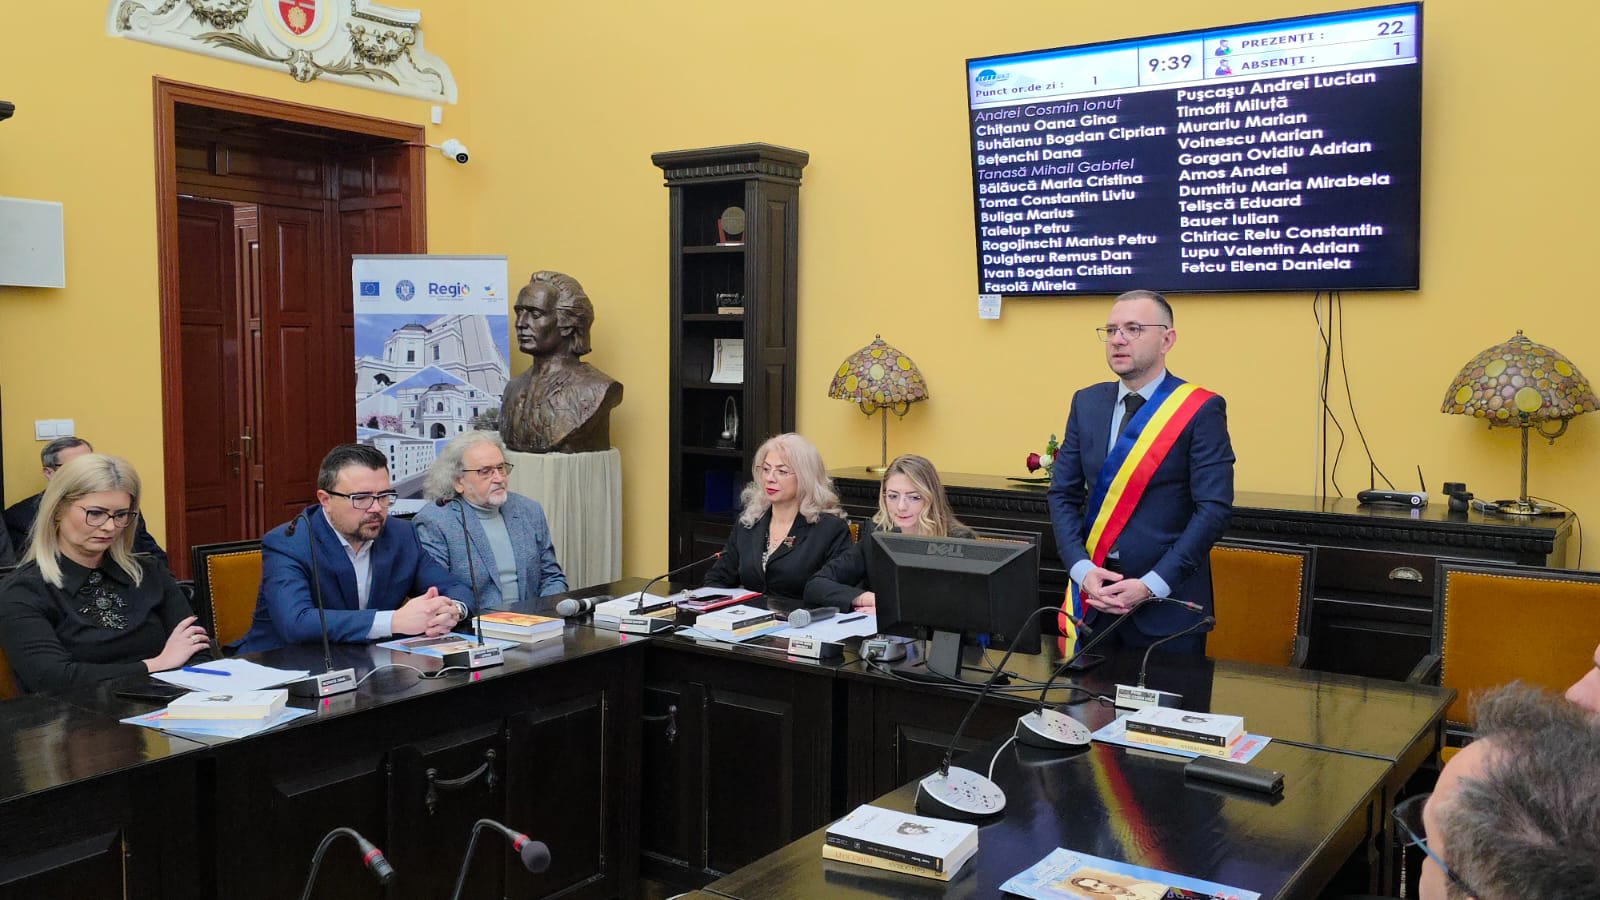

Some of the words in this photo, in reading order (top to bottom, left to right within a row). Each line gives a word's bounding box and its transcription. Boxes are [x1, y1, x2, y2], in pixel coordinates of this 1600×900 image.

[1378, 20, 1404, 36] 22
[1394, 43, 1400, 56] 1
[1149, 55, 1192, 72] 9:39
[1093, 76, 1097, 85] 1
[1250, 77, 1309, 94] Andrei
[1315, 71, 1376, 88] Lucian
[976, 88, 1007, 97] Punct
[1012, 84, 1042, 93] or.de
[975, 107, 1020, 122] Andrei
[1025, 102, 1078, 117] Cosmin
[1177, 102, 1230, 118] Timofti
[1035, 118, 1076, 131] Oana
[1080, 115, 1117, 127] Gina
[1178, 118, 1240, 134] Murariu
[1245, 113, 1307, 128] Marian
[977, 136, 1042, 150] Buhăianu
[1047, 132, 1104, 146] Bogdan
[1109, 125, 1165, 141] Ciprian
[1178, 133, 1254, 149] Voinescu
[1260, 128, 1323, 143] Marian
[1043, 149, 1082, 160] Dana
[1179, 153, 1242, 166] Gorgan
[1247, 147, 1303, 161] Ovidiu
[1309, 142, 1371, 156] Adrian
[978, 167, 1026, 180] Tanasă
[1031, 162, 1074, 176] Mihail
[1078, 158, 1134, 172] Gabriel
[1179, 169, 1225, 181] Amos
[1230, 163, 1287, 178] Andrei
[980, 182, 1036, 194] Bălăucă
[1041, 179, 1082, 190] Maria
[1087, 174, 1142, 187] Cristina
[1179, 182, 1246, 196] Dumitriu
[1251, 180, 1301, 193] Maria
[1307, 173, 1390, 189] Mirabela
[980, 197, 1017, 208] Toma
[1022, 192, 1098, 206] Constantin
[1102, 189, 1135, 202] Liviu
[1241, 195, 1301, 209] Eduard
[981, 212, 1022, 224] Buliga
[1027, 208, 1074, 220] Marius
[1181, 215, 1228, 227] Bauer
[1233, 213, 1278, 225] Iulian
[982, 225, 1030, 237] Taielup
[1035, 223, 1070, 234] Petru
[1181, 231, 1239, 242] Chiriac
[1245, 229, 1280, 241] Relu
[1286, 224, 1382, 238] Constantin
[983, 237, 1062, 251] Rogojinschi
[1066, 235, 1113, 247] Marius
[1118, 234, 1156, 245] Petru
[1182, 248, 1219, 259] Lupu
[1224, 244, 1294, 257] Valentin
[1299, 242, 1359, 254] Adrian
[984, 253, 1044, 266] Dulgheru
[1050, 251, 1097, 262] Remus
[1102, 250, 1131, 261] Dan
[1182, 262, 1225, 273] Fetcu
[1231, 260, 1276, 272] Elena
[1283, 258, 1350, 270] Daniela
[984, 268, 1013, 278] Ivan
[1018, 266, 1072, 279] Bogdan
[1077, 264, 1131, 276] Cristian
[429, 282, 470, 297] Regio
[985, 281, 1027, 292] Fasolă
[1032, 280, 1076, 291] Mirela
[927, 542, 964, 557] DELL
